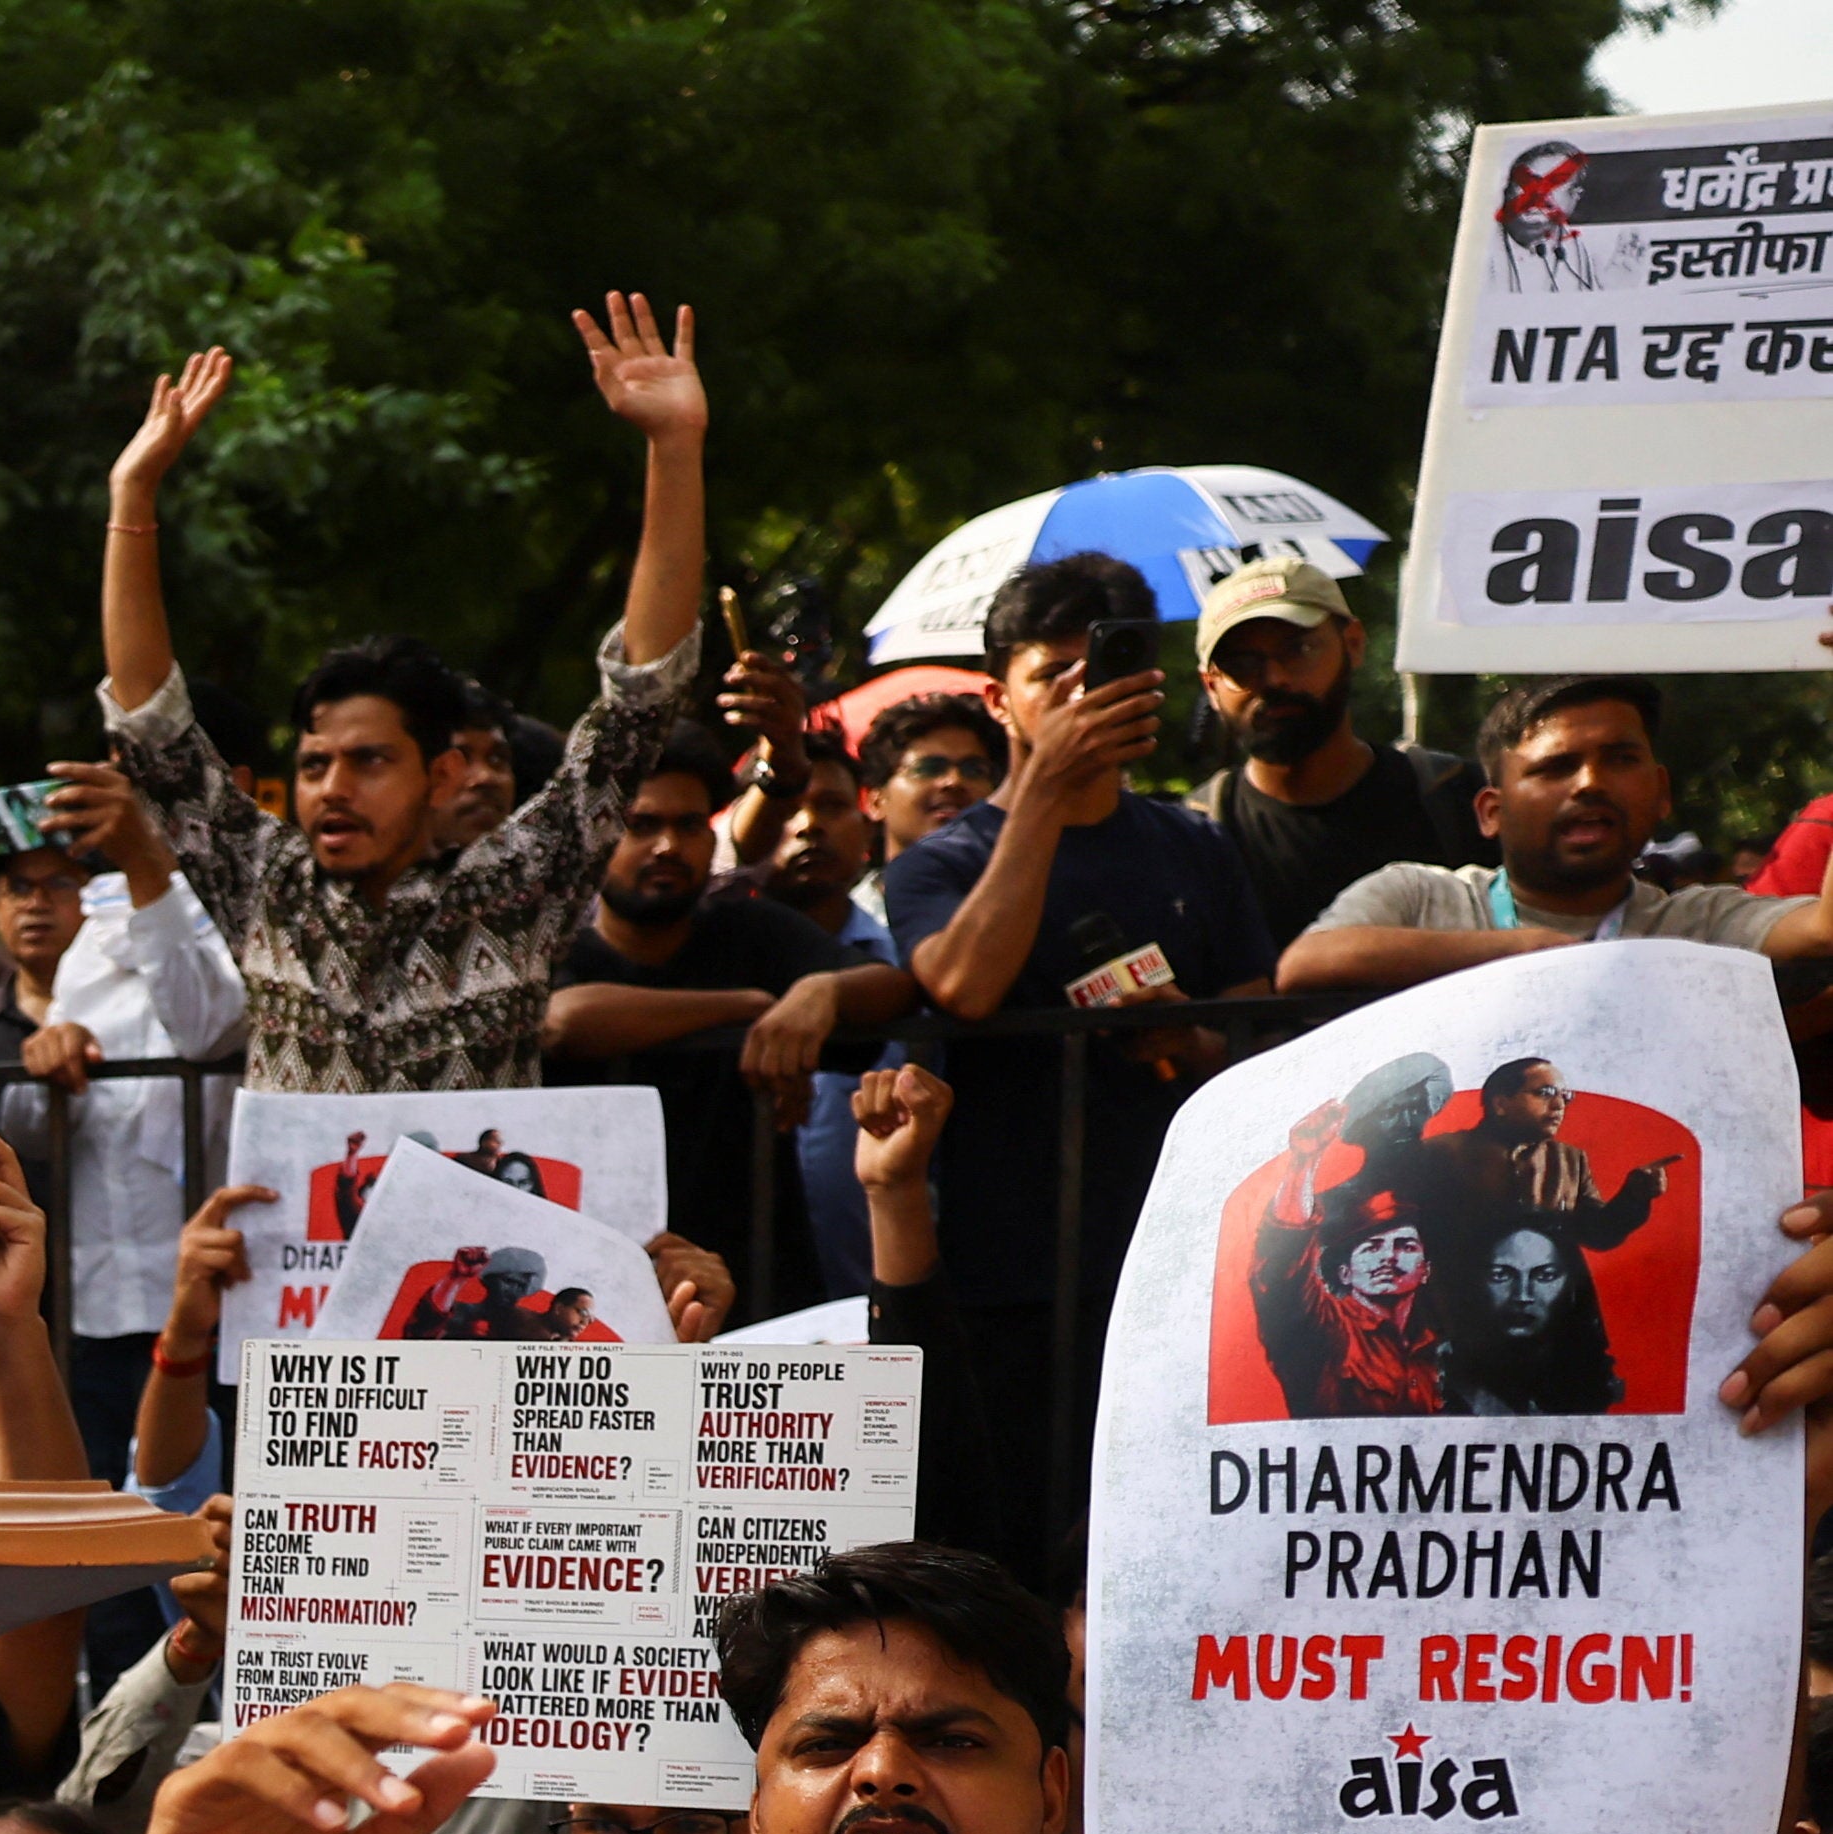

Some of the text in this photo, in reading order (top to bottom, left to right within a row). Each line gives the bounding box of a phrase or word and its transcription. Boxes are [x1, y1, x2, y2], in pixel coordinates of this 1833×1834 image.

[1647, 221, 1831, 287] इस्तीफा
[1491, 326, 1619, 384] NTA
[1640, 322, 1734, 386] रद्द
[1485, 497, 1833, 605] aisa
[271, 1354, 400, 1384] WHY IS IT
[516, 1356, 611, 1380] WHY DO
[701, 1362, 845, 1381] WHY DO PEOPLE
[269, 1387, 427, 1410] OFTEN DIFFICULT
[514, 1382, 630, 1408] OPINIONS
[701, 1382, 783, 1410] TRUST
[269, 1410, 358, 1438] TO FIND
[513, 1409, 655, 1431] SPREAD FASTER
[699, 1412, 833, 1439] AUTHORITY
[267, 1440, 439, 1470] SIMPLE FACTS?
[512, 1432, 562, 1452] THAN
[697, 1441, 825, 1464] MORE THAN
[511, 1454, 632, 1480] EVIDENCE?
[697, 1466, 850, 1491] VERIFICATION?
[1210, 1442, 1681, 1516] DHARMENDRA
[245, 1504, 376, 1534] CAN TRUTH
[485, 1520, 642, 1537] WHAT IF EVERY IMPORTANT
[698, 1517, 827, 1542] CAN CITIZENS
[245, 1533, 313, 1554] BECOME
[485, 1537, 637, 1553] PUBLIC CLAIM CAME WITH
[243, 1555, 369, 1576] EASIER TO FIND
[482, 1554, 665, 1593] EVIDENCE?
[1285, 1529, 1604, 1600] PRADHAN
[242, 1576, 284, 1594] THAN
[241, 1596, 417, 1626] MISINFORMATION?
[484, 1641, 710, 1668] WHAT WOULD A SOCIETY
[1192, 1633, 1694, 1703] MUST RESIGN!
[482, 1665, 724, 1698] LOOK LIKE IF EVIDEN
[595, 1698, 655, 1720] MORE
[663, 1700, 720, 1723] THAN
[480, 1717, 652, 1752] IDEOLOGY?
[1339, 1723, 1519, 1820] aisa
